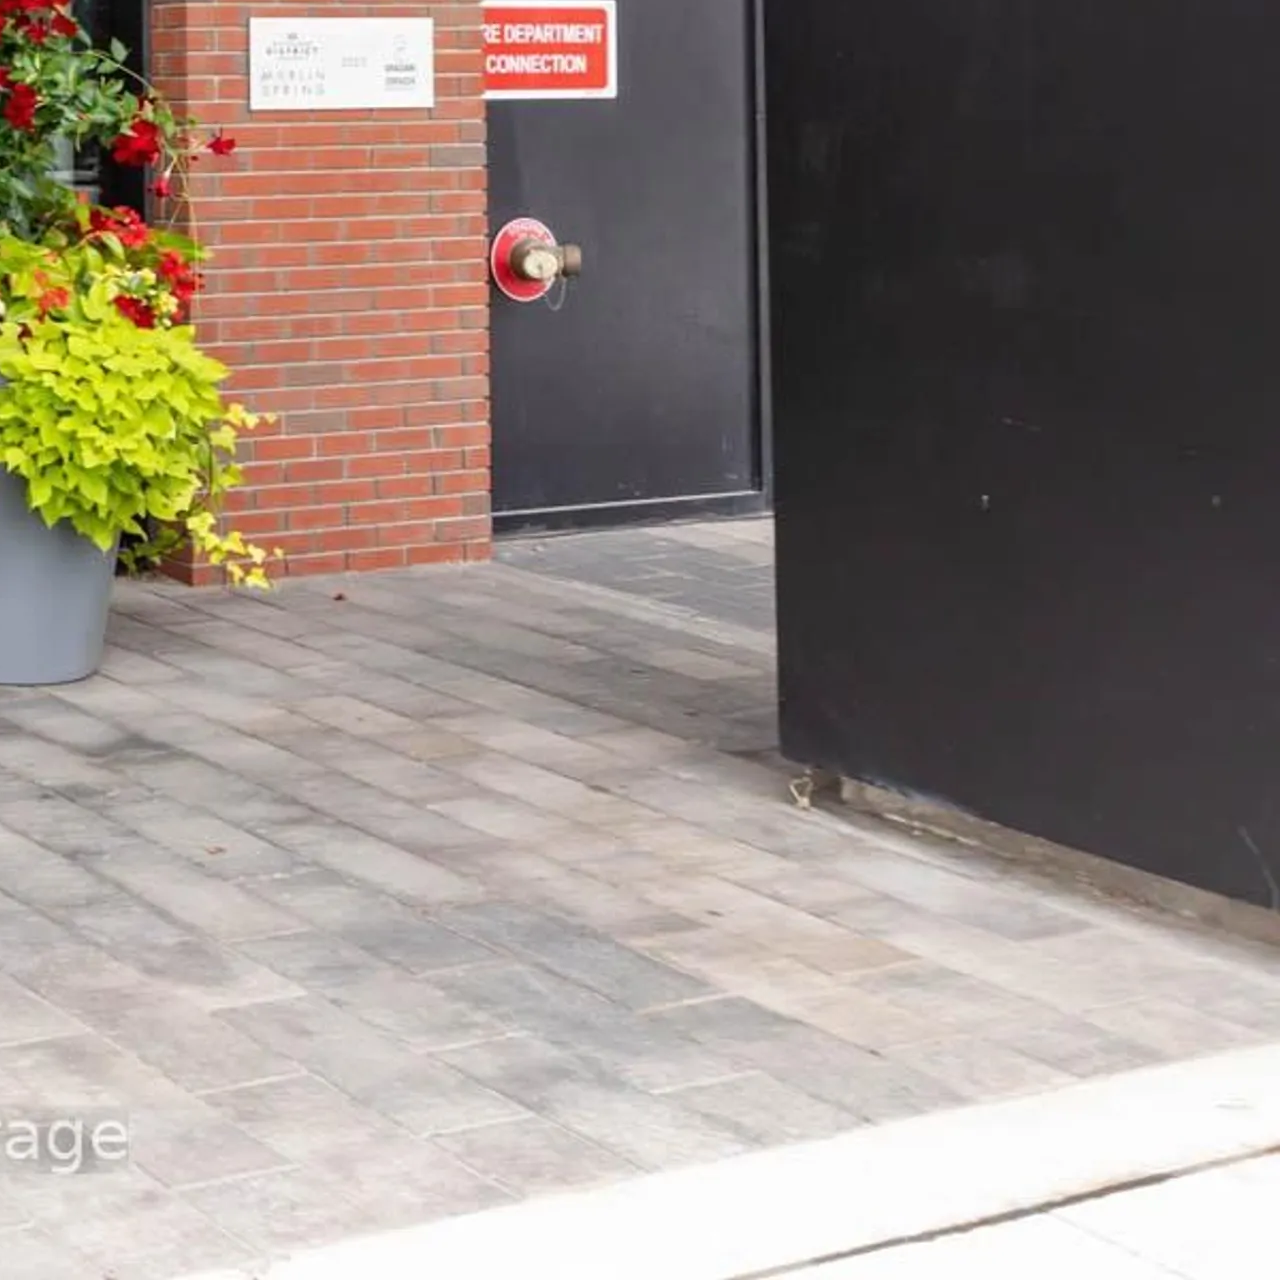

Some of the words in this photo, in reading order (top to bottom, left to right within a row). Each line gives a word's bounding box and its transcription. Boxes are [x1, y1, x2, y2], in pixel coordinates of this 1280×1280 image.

[481, 23, 501, 44] RE
[503, 23, 604, 44] DEPARTMENT
[486, 53, 588, 75] CONNECTION
